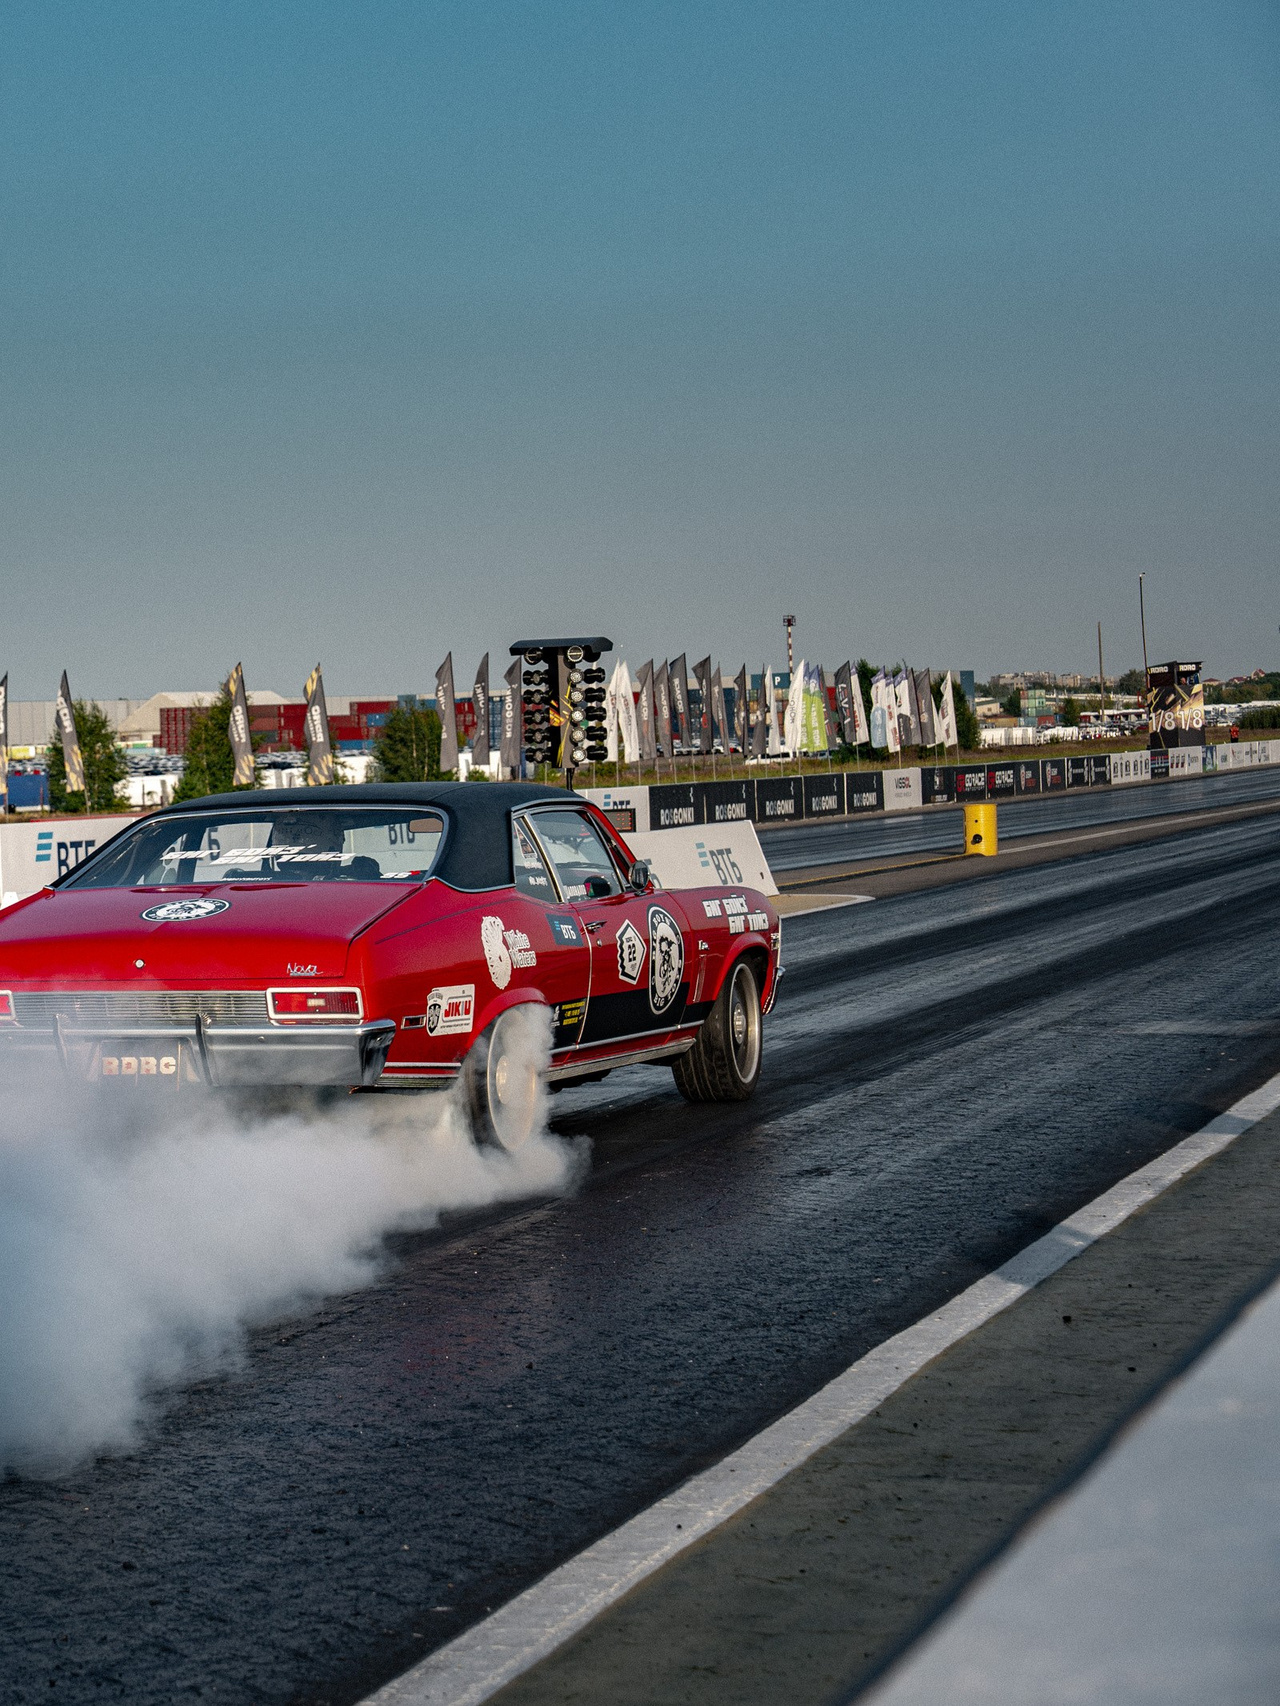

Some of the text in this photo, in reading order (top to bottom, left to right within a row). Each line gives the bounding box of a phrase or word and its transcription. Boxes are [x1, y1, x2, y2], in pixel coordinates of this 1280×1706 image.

[1150, 710, 1176, 732] 1/8
[1177, 709, 1203, 731] 1/8
[765, 799, 795, 816] ROSGONKI
[812, 795, 838, 811] ROSGONKI
[853, 792, 877, 807] ROSGONKI
[660, 806, 694, 825] ROSGONKI
[715, 803, 747, 820] ROSGONKI
[709, 847, 743, 885] ВТБ
[702, 900, 722, 917] БИГ
[560, 925, 577, 939] ВТБ
[728, 915, 745, 934] БИГ
[503, 930, 530, 950] White
[509, 950, 537, 968] Waters
[628, 944, 636, 962] 22
[287, 963, 323, 975] Nova
[102, 1057, 176, 1075] RDRC
